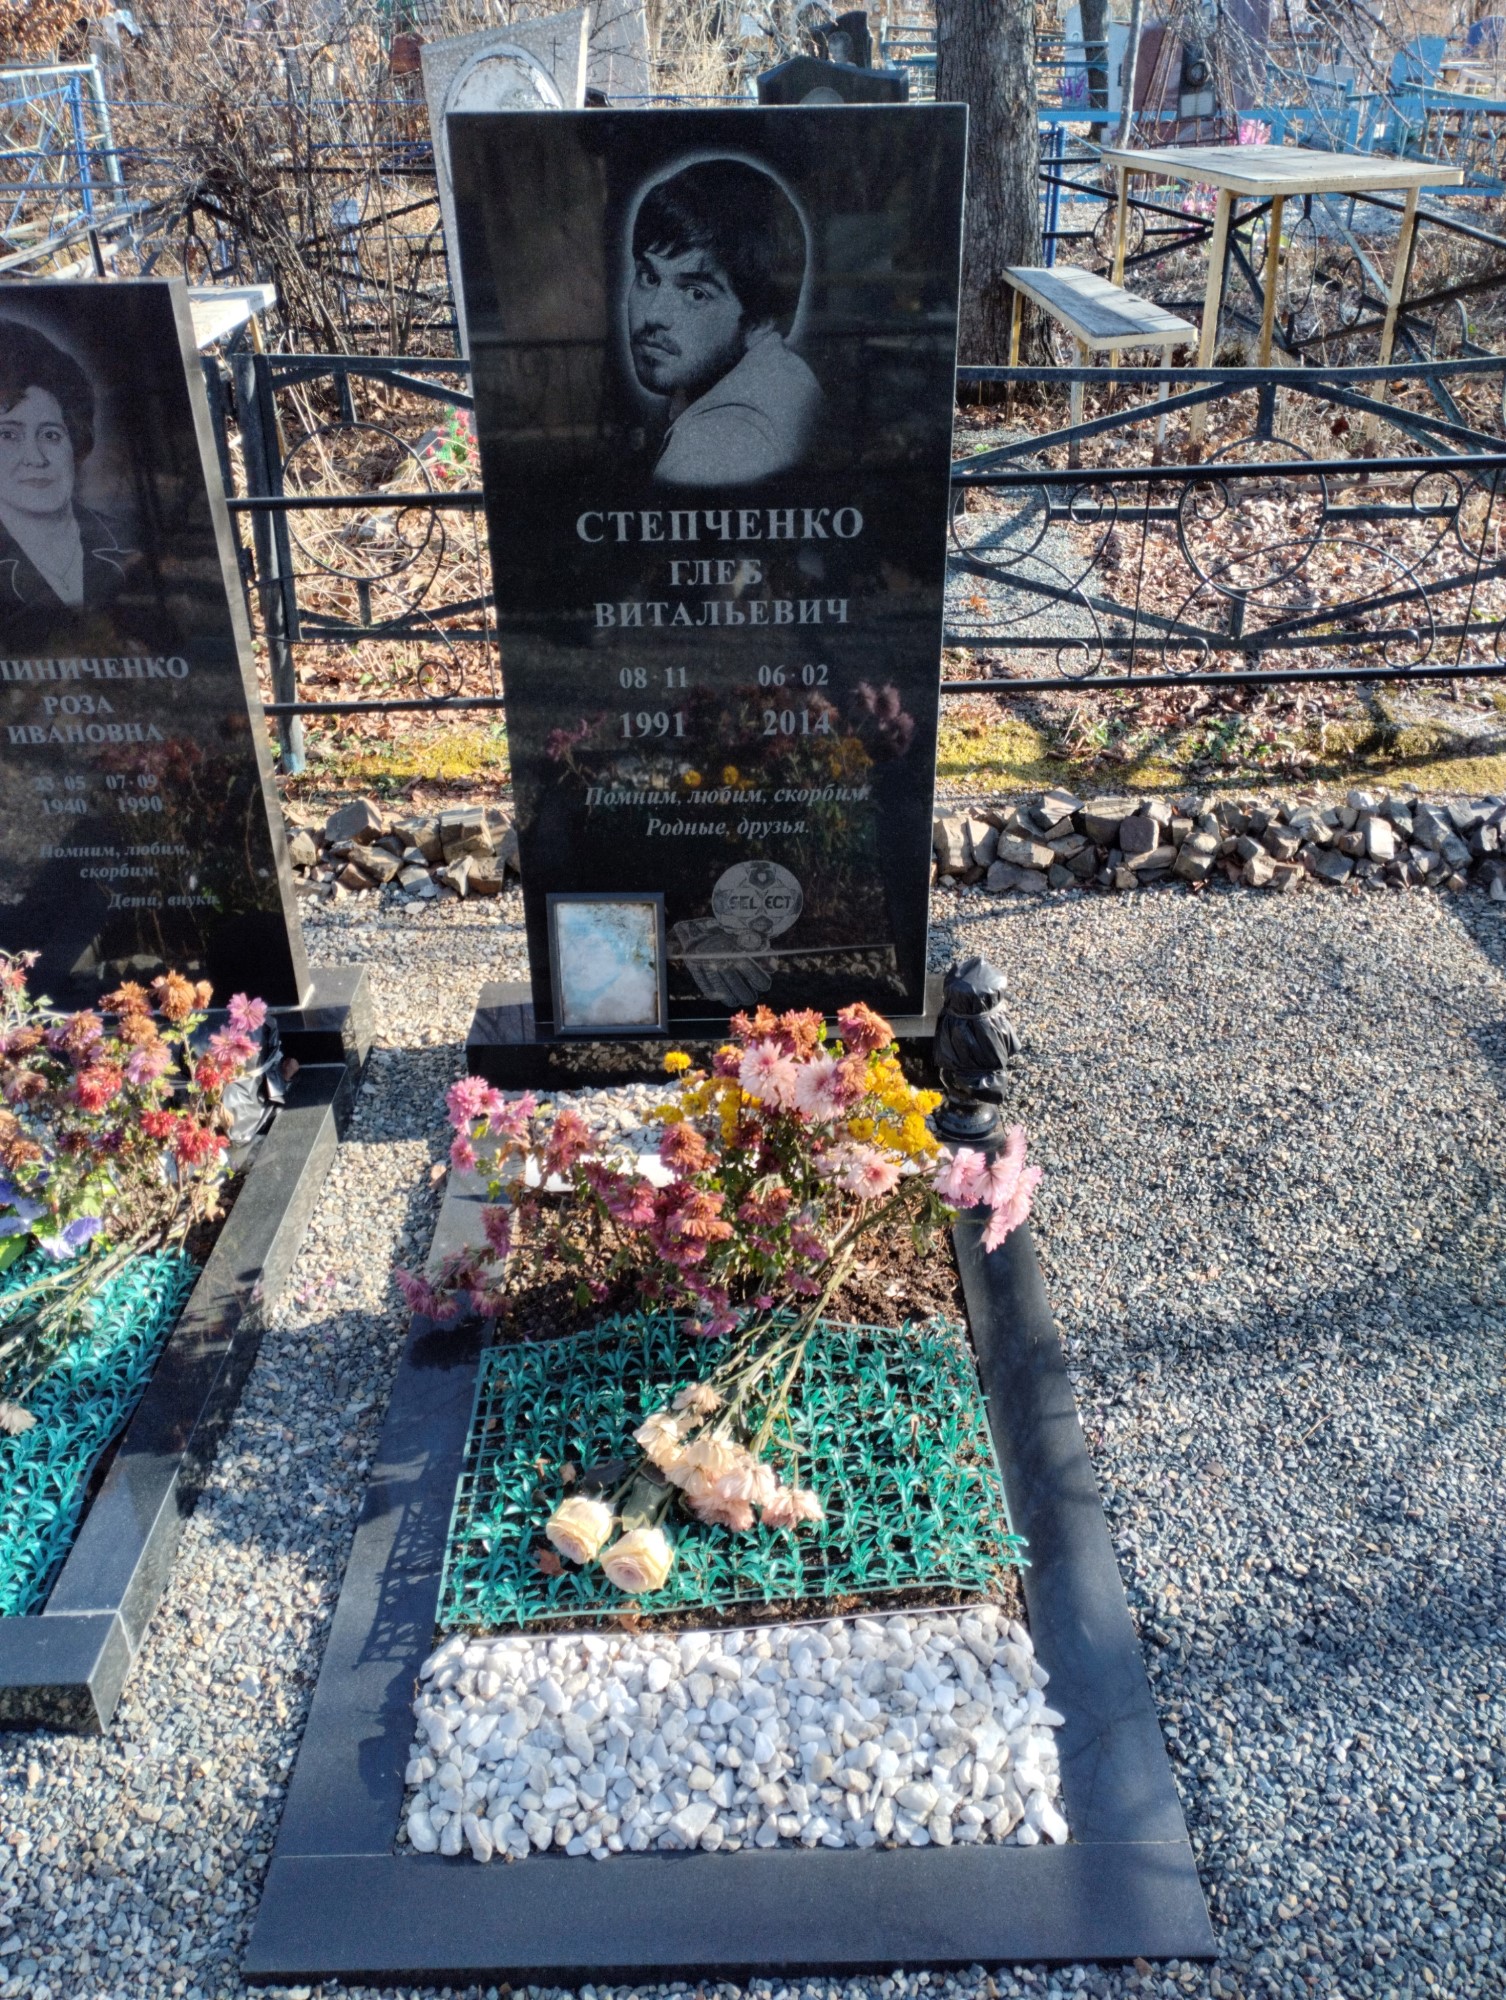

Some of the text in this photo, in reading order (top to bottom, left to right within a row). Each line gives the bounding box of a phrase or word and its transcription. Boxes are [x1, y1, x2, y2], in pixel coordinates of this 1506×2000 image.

[576, 507, 864, 543] СТЕПЧЕНКО
[669, 559, 763, 586] ГЛЕБ
[594, 600, 850, 628] ВИТАЛЬЕВИЧ
[42, 694, 116, 715] РОЗА
[7, 723, 166, 744] ИВАНОВНА
[619, 709, 831, 738] 1991 2014
[42, 795, 163, 814] 1940 1990
[686, 785, 767, 804] любим,
[736, 817, 810, 840] друзья.
